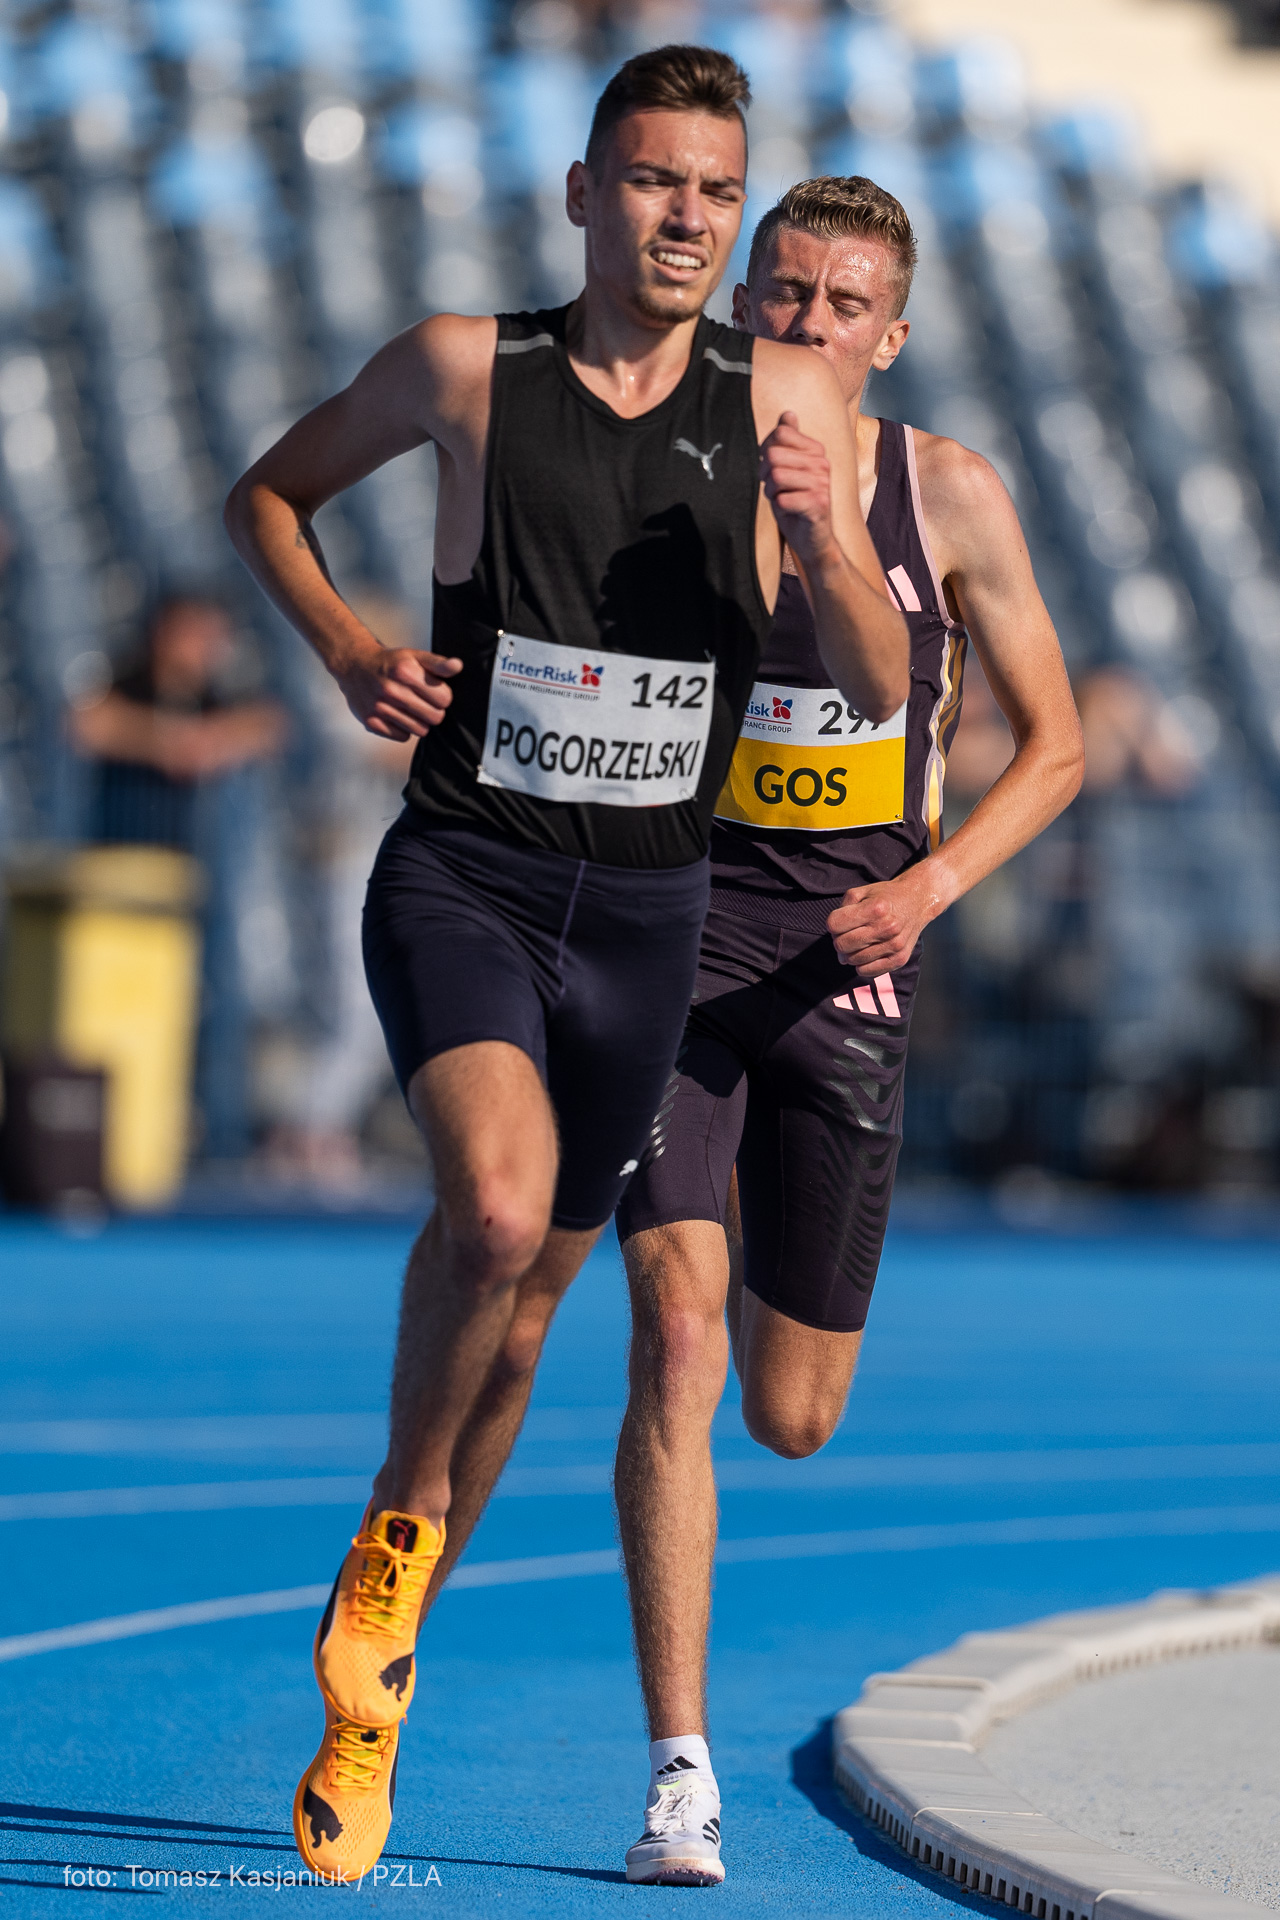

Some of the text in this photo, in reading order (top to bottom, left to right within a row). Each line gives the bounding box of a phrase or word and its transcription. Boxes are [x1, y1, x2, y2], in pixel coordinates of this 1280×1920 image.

[501, 656, 578, 685] InterRisk
[631, 672, 708, 709] 142
[743, 720, 792, 734] RANCE GROUP
[817, 700, 881, 736] 29
[493, 717, 701, 781] POGORZELSKI
[753, 763, 848, 808] GOS
